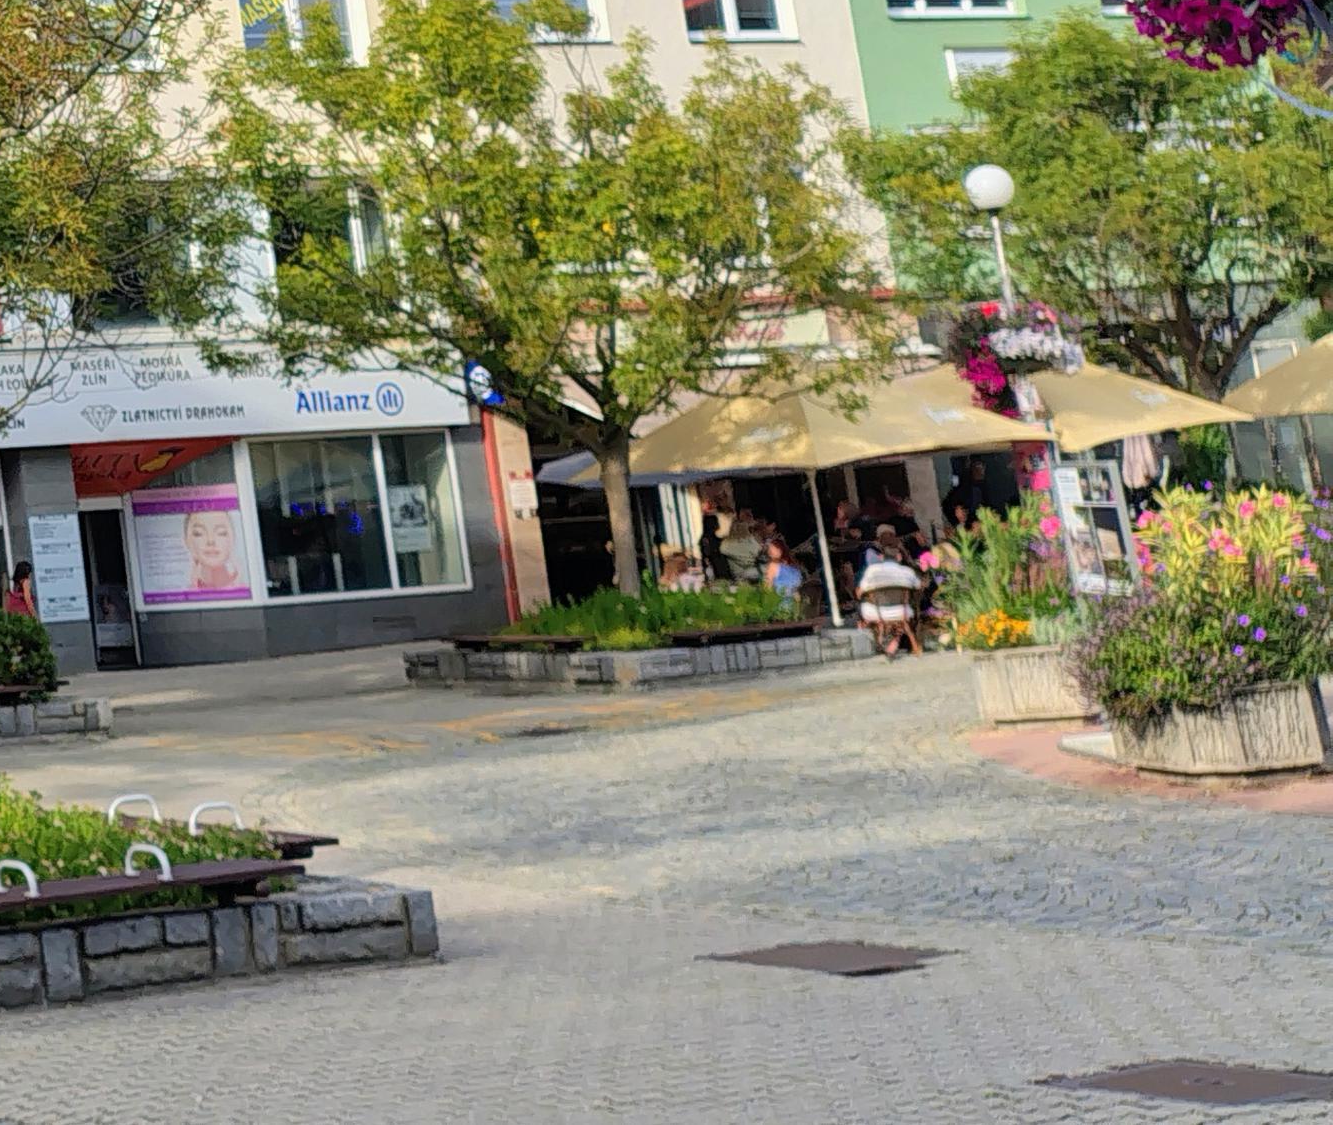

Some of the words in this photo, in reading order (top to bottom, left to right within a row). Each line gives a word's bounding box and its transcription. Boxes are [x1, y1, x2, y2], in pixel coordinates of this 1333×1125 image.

[72, 358, 116, 372] MASÉŘI
[140, 355, 183, 368] MOKRÁ
[82, 373, 108, 386] ZLÍN
[296, 388, 370, 414] Allianz
[122, 405, 183, 423] ZLATNICTVÍ
[186, 404, 245, 421] DRAHOKAM
